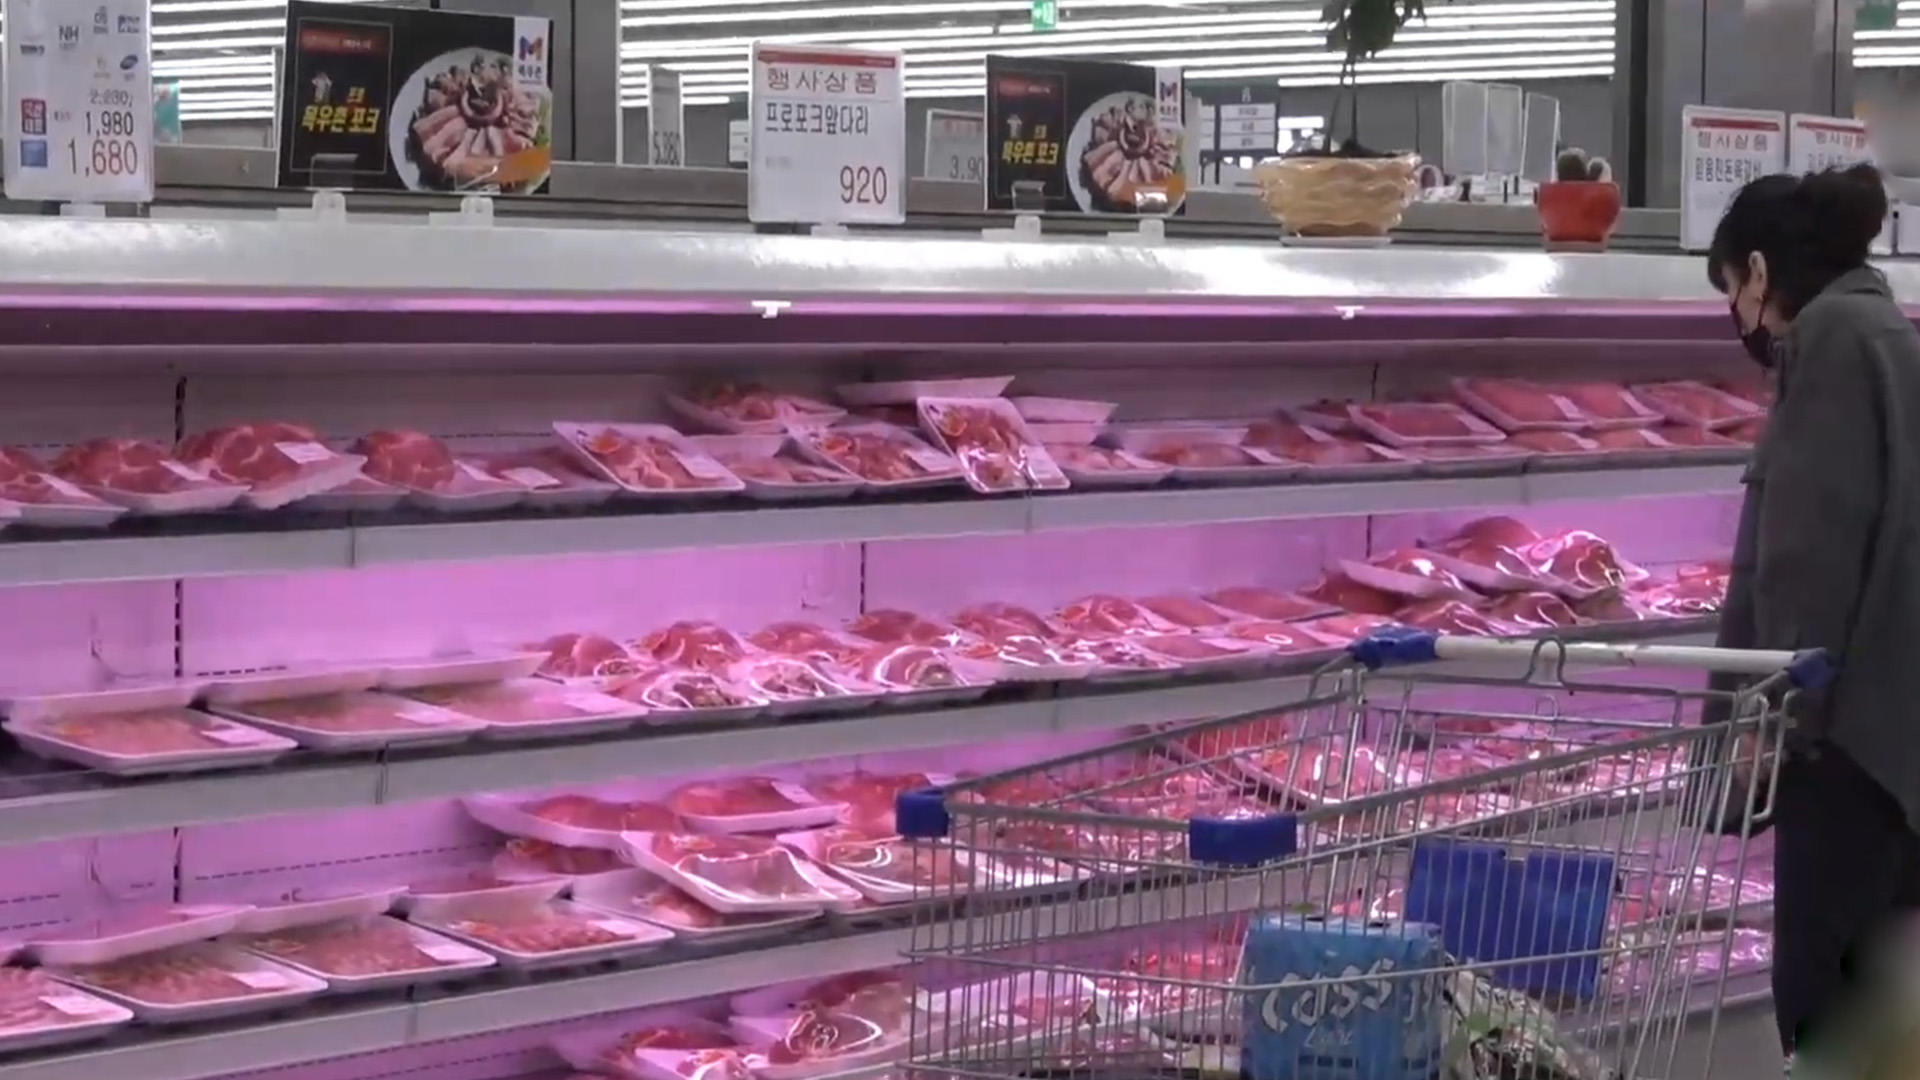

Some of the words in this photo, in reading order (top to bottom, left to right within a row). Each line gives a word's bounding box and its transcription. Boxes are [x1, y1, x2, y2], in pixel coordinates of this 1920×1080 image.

[767, 67, 878, 94] 행사상품
[86, 110, 134, 137] 1,980
[347, 106, 380, 134] 포크
[765, 101, 870, 136] 프로포크앞다리
[68, 138, 138, 177] 1,680
[840, 165, 888, 205] 920
